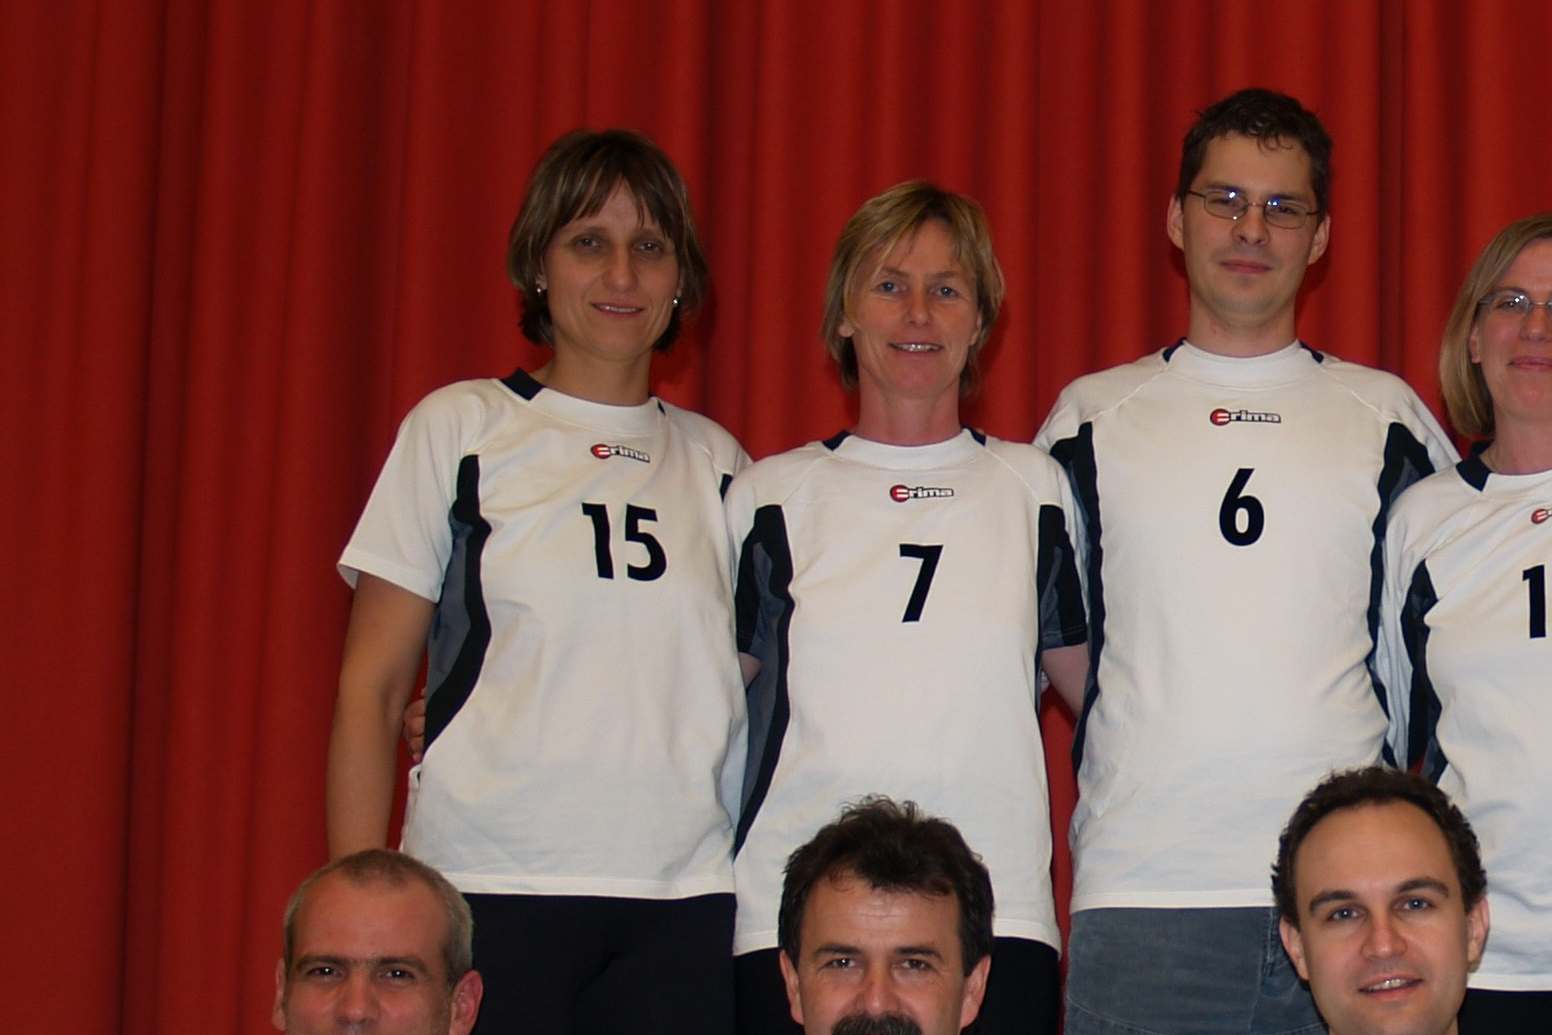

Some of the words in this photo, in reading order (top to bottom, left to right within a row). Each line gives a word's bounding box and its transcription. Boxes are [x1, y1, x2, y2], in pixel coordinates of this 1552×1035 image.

[581, 502, 667, 582] 15
[1219, 468, 1265, 547] 6
[899, 543, 944, 623] 7
